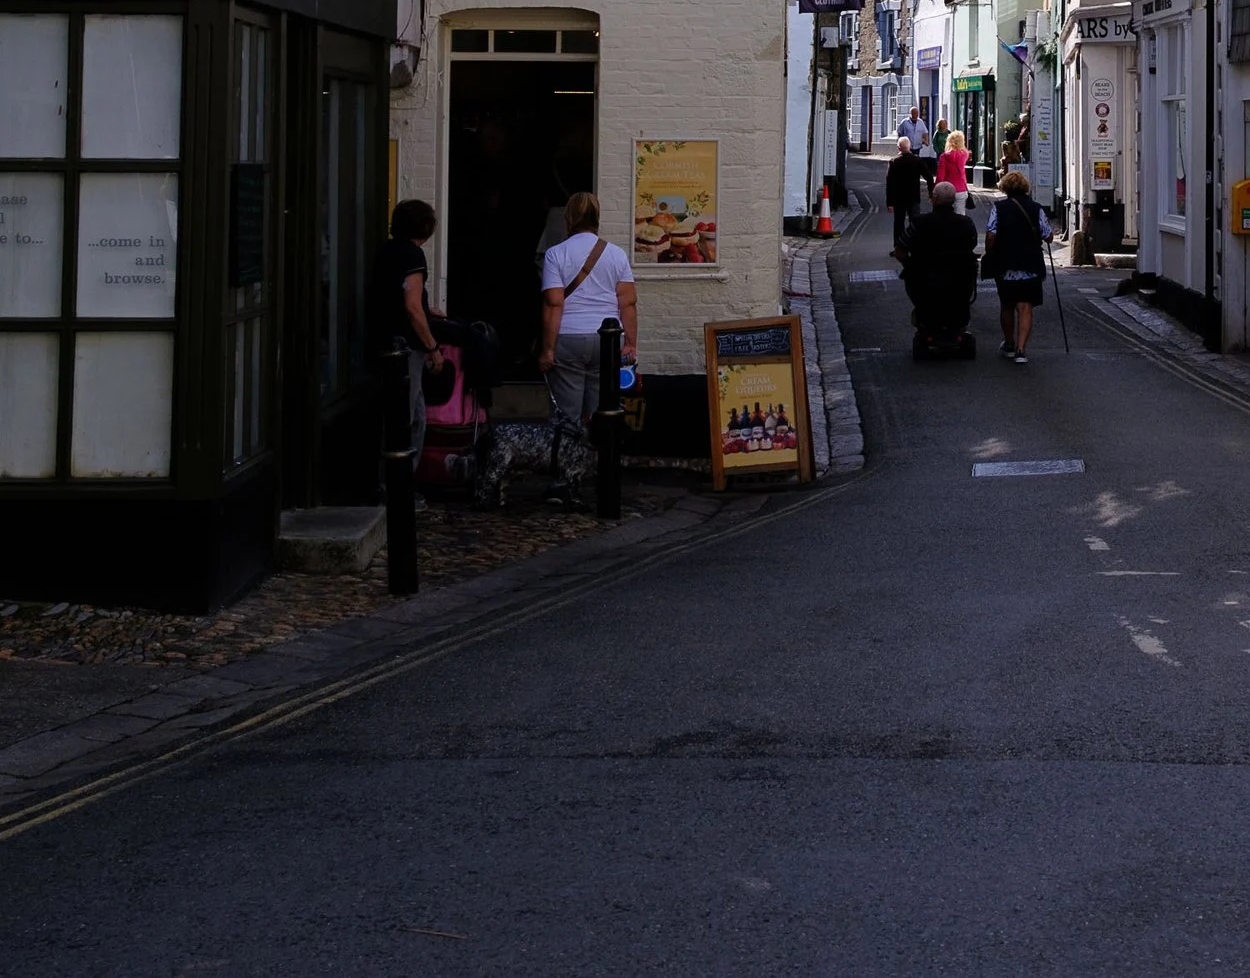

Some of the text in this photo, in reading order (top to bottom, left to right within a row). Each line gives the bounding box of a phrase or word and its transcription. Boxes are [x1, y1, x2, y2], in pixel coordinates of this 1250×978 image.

[1114, 20, 1130, 39] by
[88, 235, 165, 248] ...come in
[135, 254, 165, 266] and
[104, 272, 165, 285] browse.
